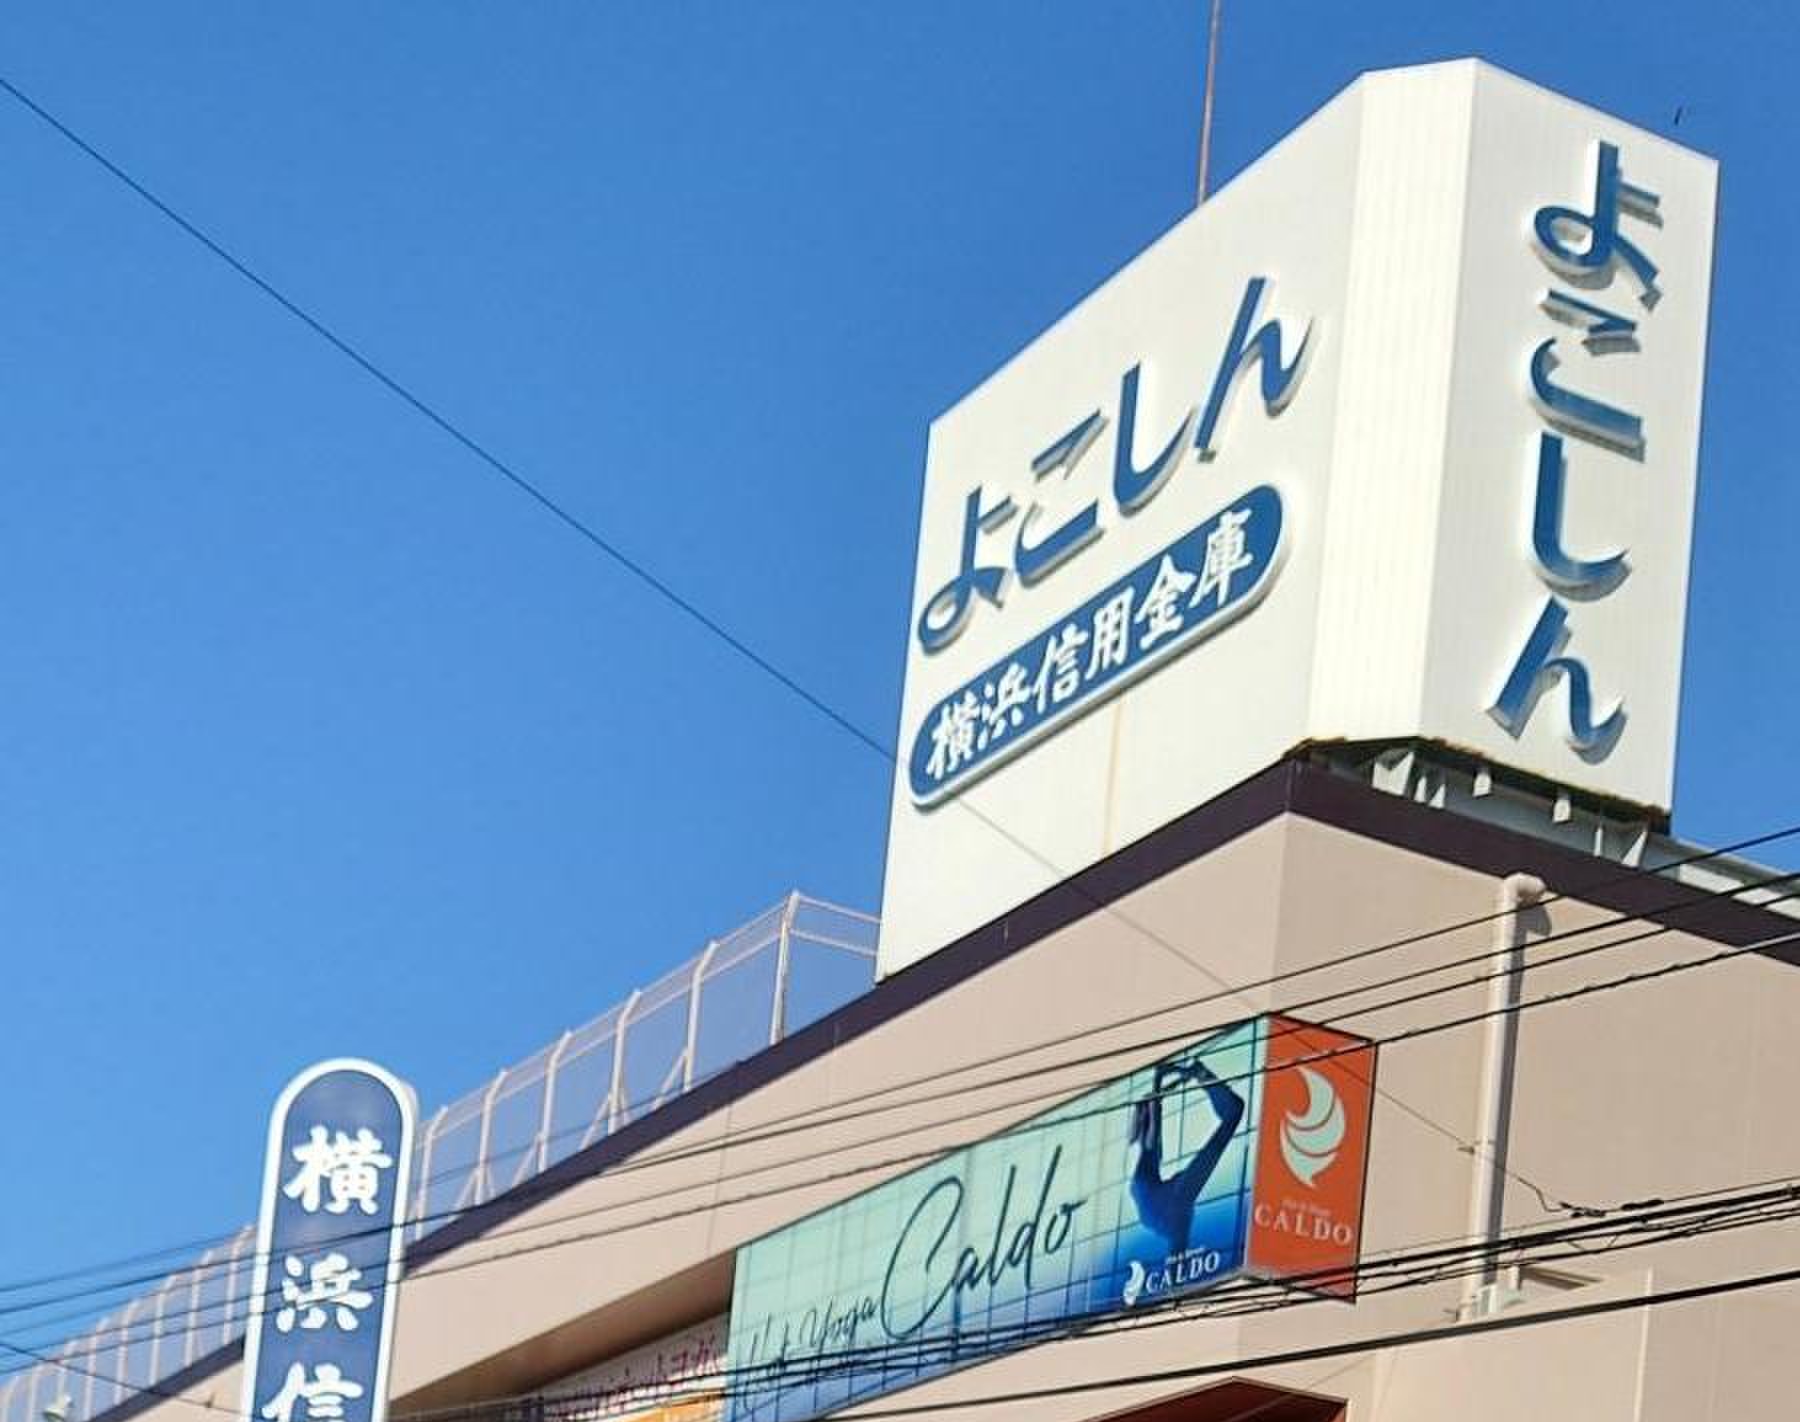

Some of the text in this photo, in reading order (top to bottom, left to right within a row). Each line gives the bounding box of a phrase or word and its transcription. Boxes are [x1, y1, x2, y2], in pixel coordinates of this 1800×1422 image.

[918, 277, 1313, 655] よこしん
[1487, 139, 1664, 762] よこしん
[927, 508, 1253, 779] 横浜信用金庫
[881, 1144, 1089, 1339] Caldo
[1145, 1251, 1221, 1294] CALDO
[1253, 1203, 1353, 1247] CALDO
